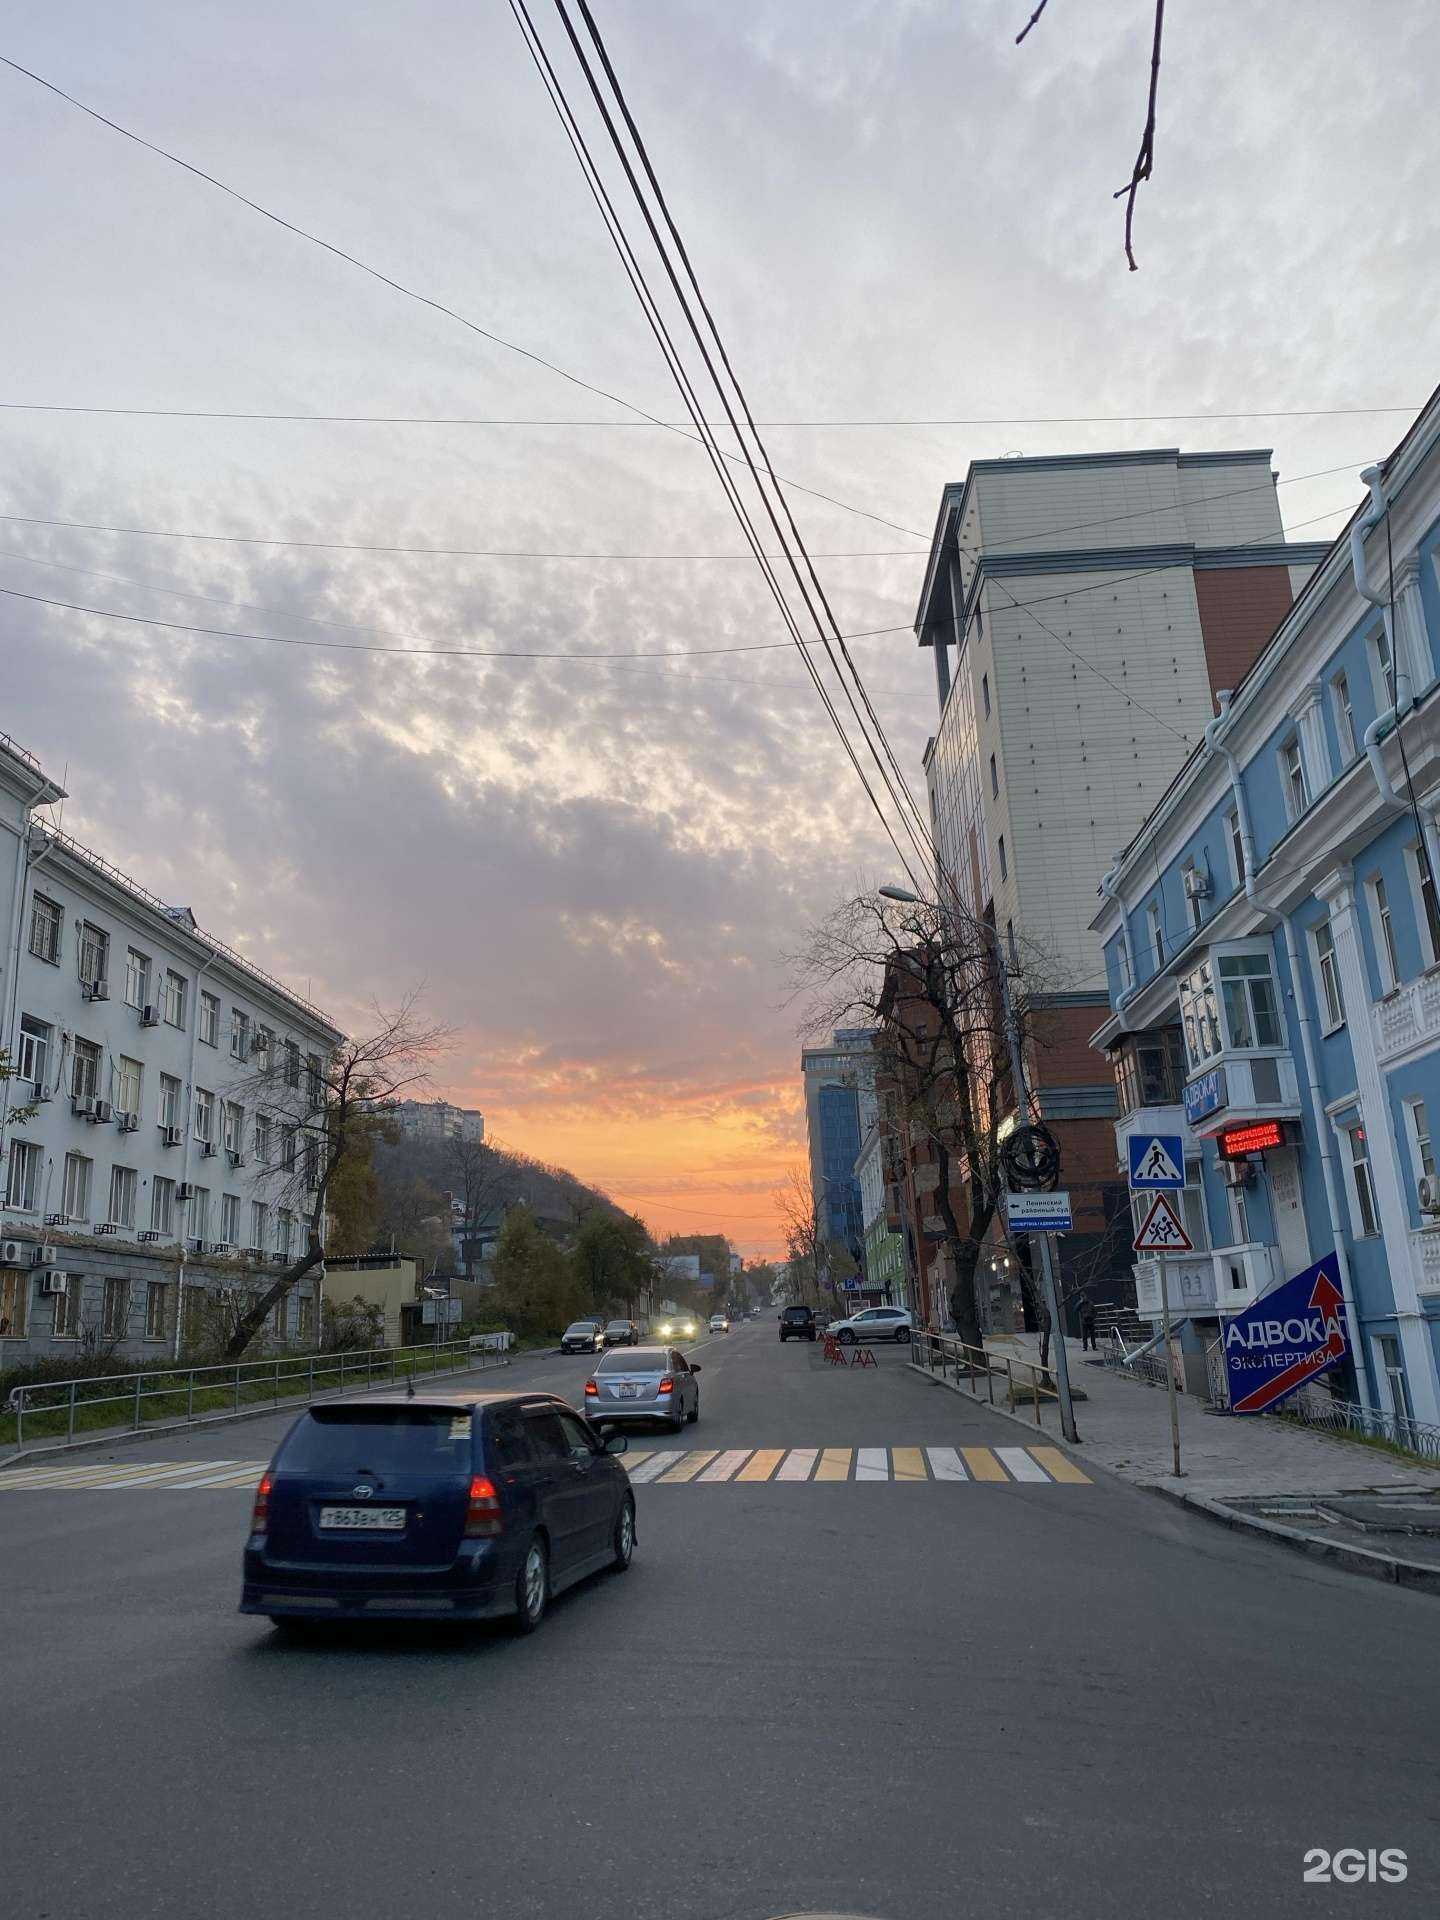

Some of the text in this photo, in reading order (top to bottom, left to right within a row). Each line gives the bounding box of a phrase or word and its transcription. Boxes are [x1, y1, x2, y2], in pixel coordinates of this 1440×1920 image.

[1185, 1070, 1220, 1110] АДВОКАТ
[1225, 1123, 1278, 1143] ОФОРМЛЕНИЕ
[1227, 1135, 1281, 1154] НАСЛЕДСТВА
[1231, 1350, 1337, 1370] ЭКСПЕРТИЗА
